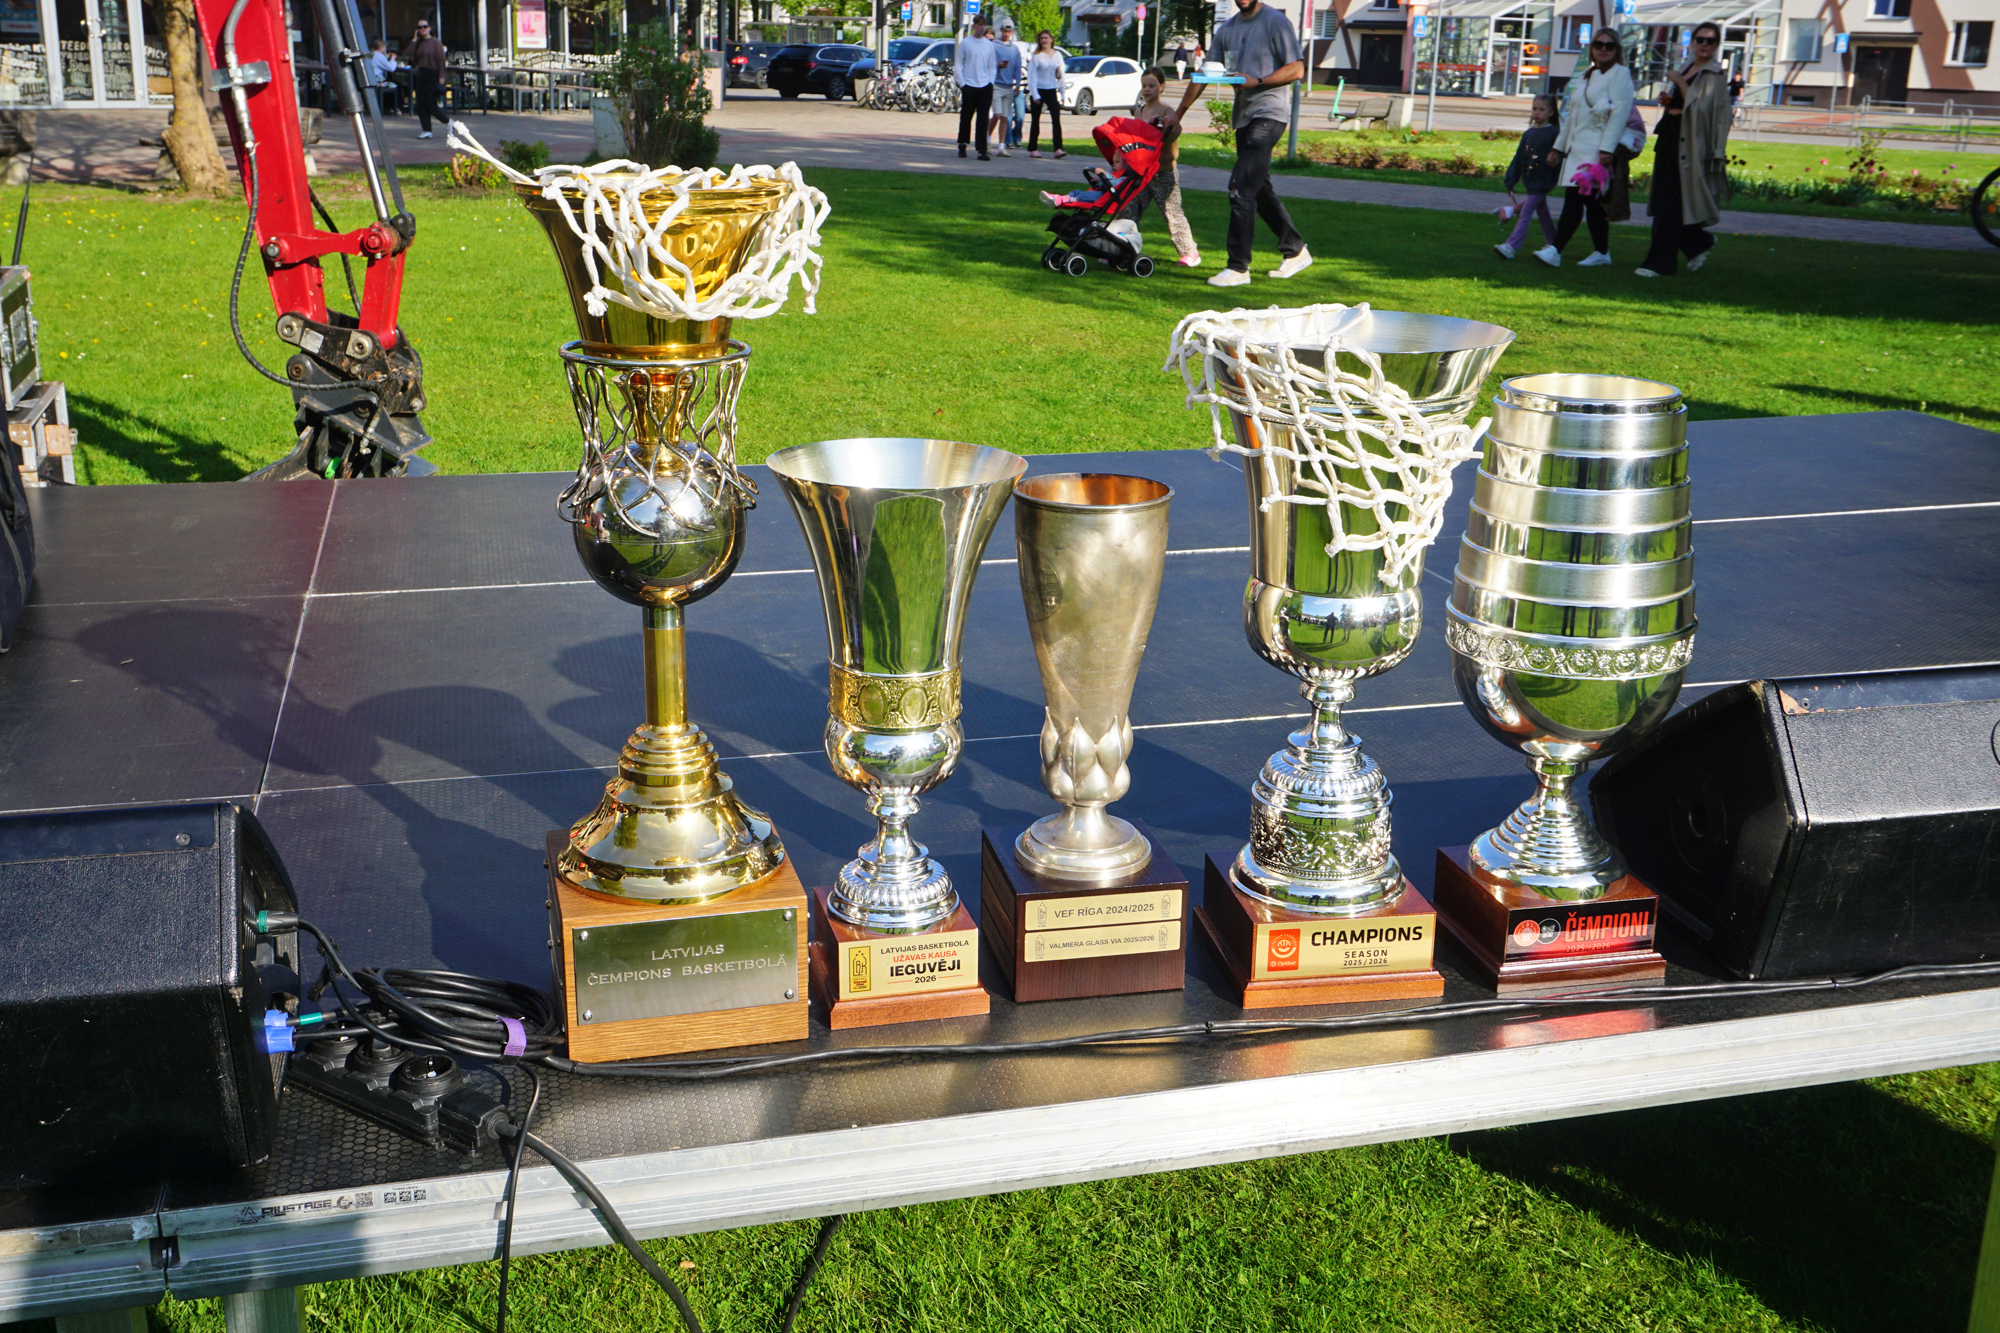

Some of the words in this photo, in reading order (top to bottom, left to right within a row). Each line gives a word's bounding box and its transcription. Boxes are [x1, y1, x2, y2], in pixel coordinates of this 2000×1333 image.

[1054, 909, 1074, 918] VEF
[1077, 907, 1103, 917] RĪGA
[1106, 903, 1155, 915] 2024/2025
[1564, 911, 1649, 943] ČEMPIONI
[1049, 941, 1084, 950] VALMIERA
[1085, 938, 1109, 947] GLASS
[1123, 935, 1155, 943] 2025/2026
[1311, 926, 1423, 947] CHAMPIONS
[651, 944, 725, 961] LATVIJAS
[880, 945, 917, 955] LATVIJAS
[918, 940, 969, 951] BASKETBOLA
[1344, 949, 1388, 959] SEASON
[893, 951, 927, 963] UŽAVAS
[928, 950, 957, 959] KAUSA
[587, 967, 672, 986] ČEMPIONS
[681, 954, 788, 977] BASKETBOLĀ
[890, 958, 961, 977] IEGUVĒJI
[914, 975, 937, 984] 2026
